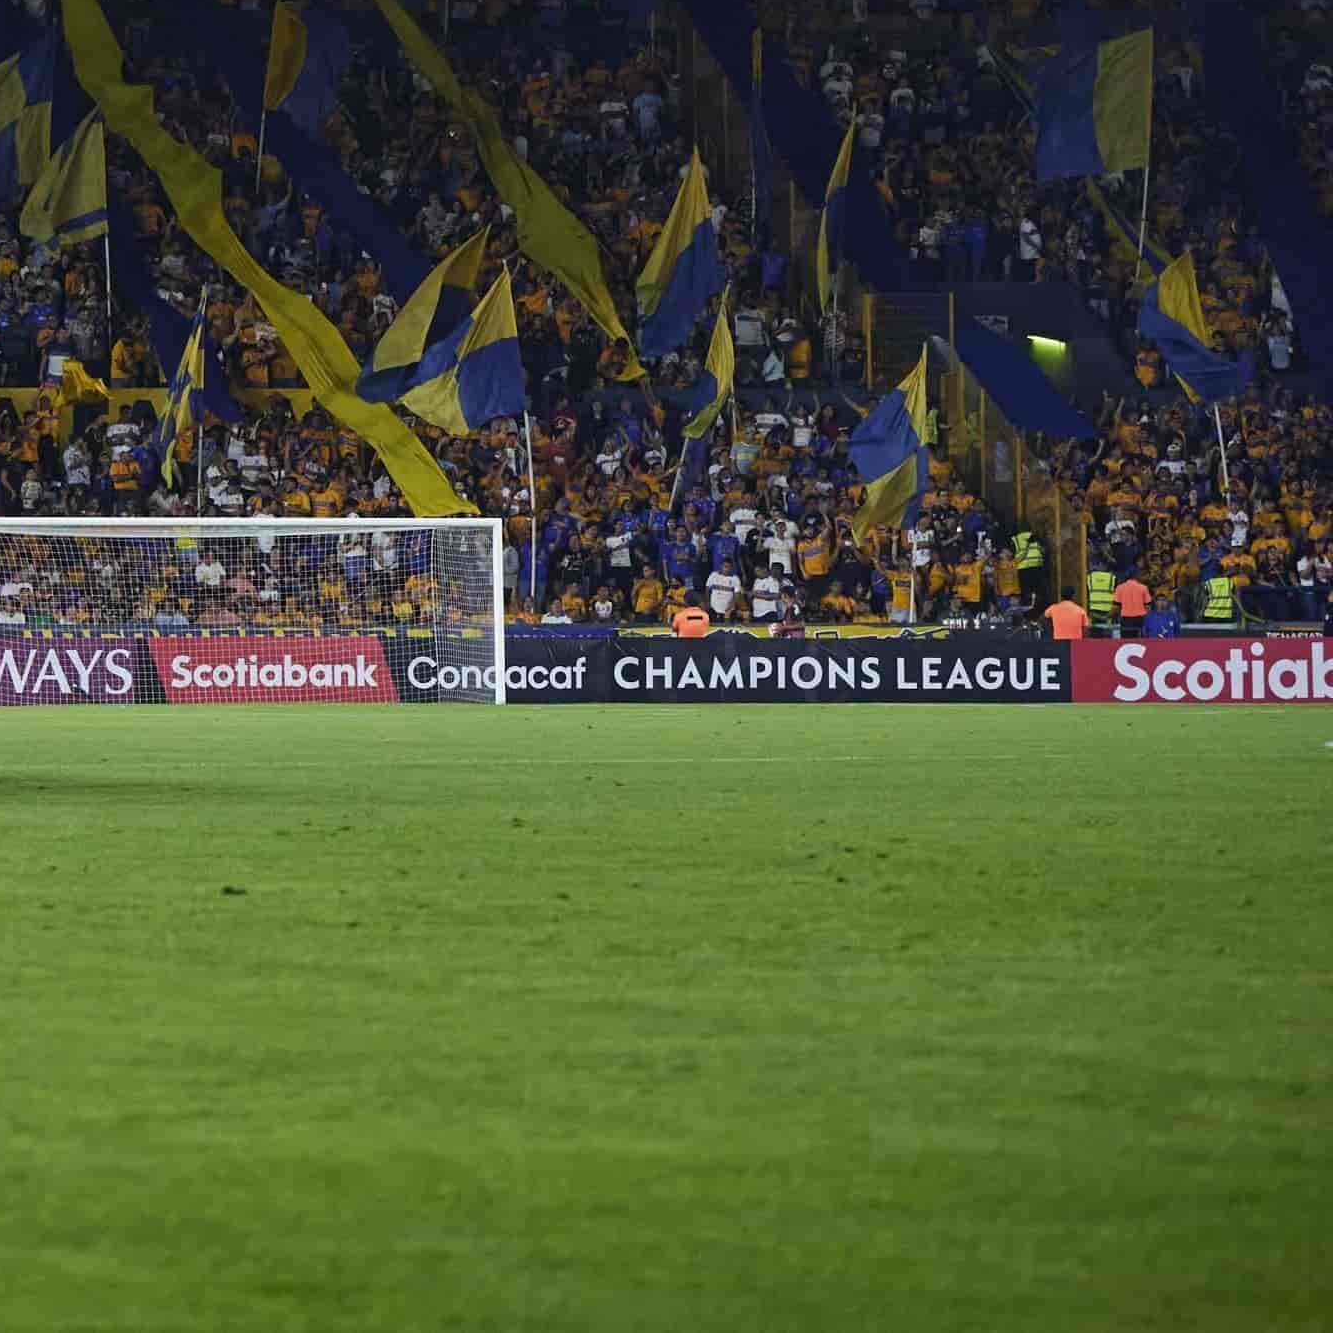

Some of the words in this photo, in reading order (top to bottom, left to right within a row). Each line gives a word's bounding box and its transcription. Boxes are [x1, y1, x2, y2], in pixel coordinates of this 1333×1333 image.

[171, 654, 378, 689] Scotiabank
[613, 656, 881, 691] CHAMPIONS
[897, 657, 1061, 691] LEAGUE
[1113, 642, 1333, 702] Scotiab
